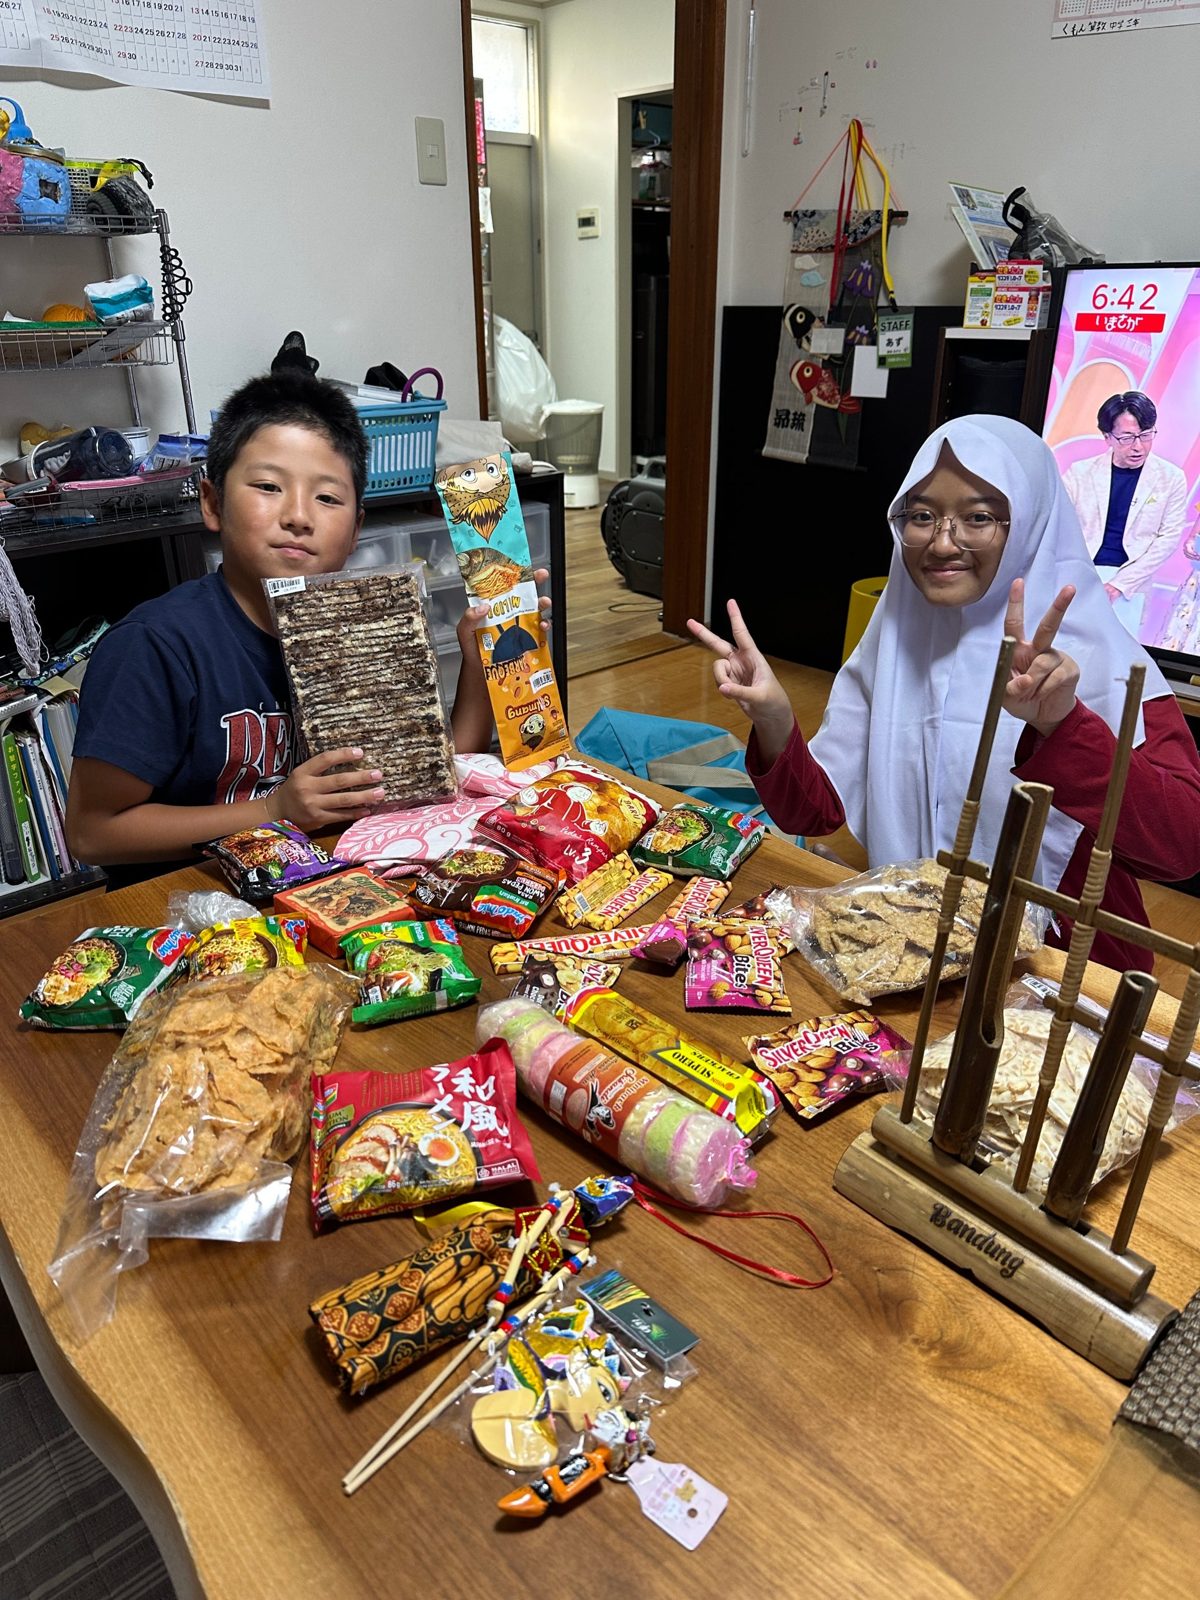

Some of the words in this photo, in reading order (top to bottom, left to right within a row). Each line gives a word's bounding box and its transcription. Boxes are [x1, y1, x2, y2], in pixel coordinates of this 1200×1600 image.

[0, 1, 10, 9] 26
[12, 2, 21, 10] 27
[142, 1, 151, 9] 18
[153, 2, 162, 10] 19
[163, 3, 173, 11] 20
[174, 4, 183, 12] 21
[201, 8, 210, 16] 14
[211, 9, 219, 18] 15
[221, 11, 229, 19] 16
[229, 12, 238, 20] 17
[238, 14, 247, 22] 18
[248, 15, 256, 24] 19
[113, 24, 123, 32] 22
[124, 25, 133, 33] 23
[134, 27, 144, 35] 24
[145, 28, 155, 36] 25
[155, 29, 165, 37] 26
[166, 31, 176, 39] 27
[176, 32, 187, 40] 28
[192, 34, 202, 42] 20
[202, 35, 211, 43] 21
[212, 36, 222, 44] 22
[222, 38, 232, 46] 23
[232, 39, 240, 47] 24
[241, 40, 250, 48] 25
[249, 41, 259, 50] 26
[117, 51, 127, 59] 29
[128, 52, 137, 60] 30
[195, 60, 204, 68] 27
[205, 61, 214, 69] 28
[214, 62, 224, 70] 29
[224, 63, 234, 71] 30
[234, 64, 242, 72] 31
[1092, 283, 1158, 310] 6:42
[880, 319, 910, 332] STAFF
[601, 872, 660, 917] SILVERQUEEN
[734, 954, 751, 989] Bites
[671, 1051, 714, 1079] SUPERO
[427, 1063, 457, 1131] ラーメン
[451, 1067, 509, 1136] 和風
[491, 1162, 517, 1172] HALAL
[930, 1202, 1024, 1278] Bandung
